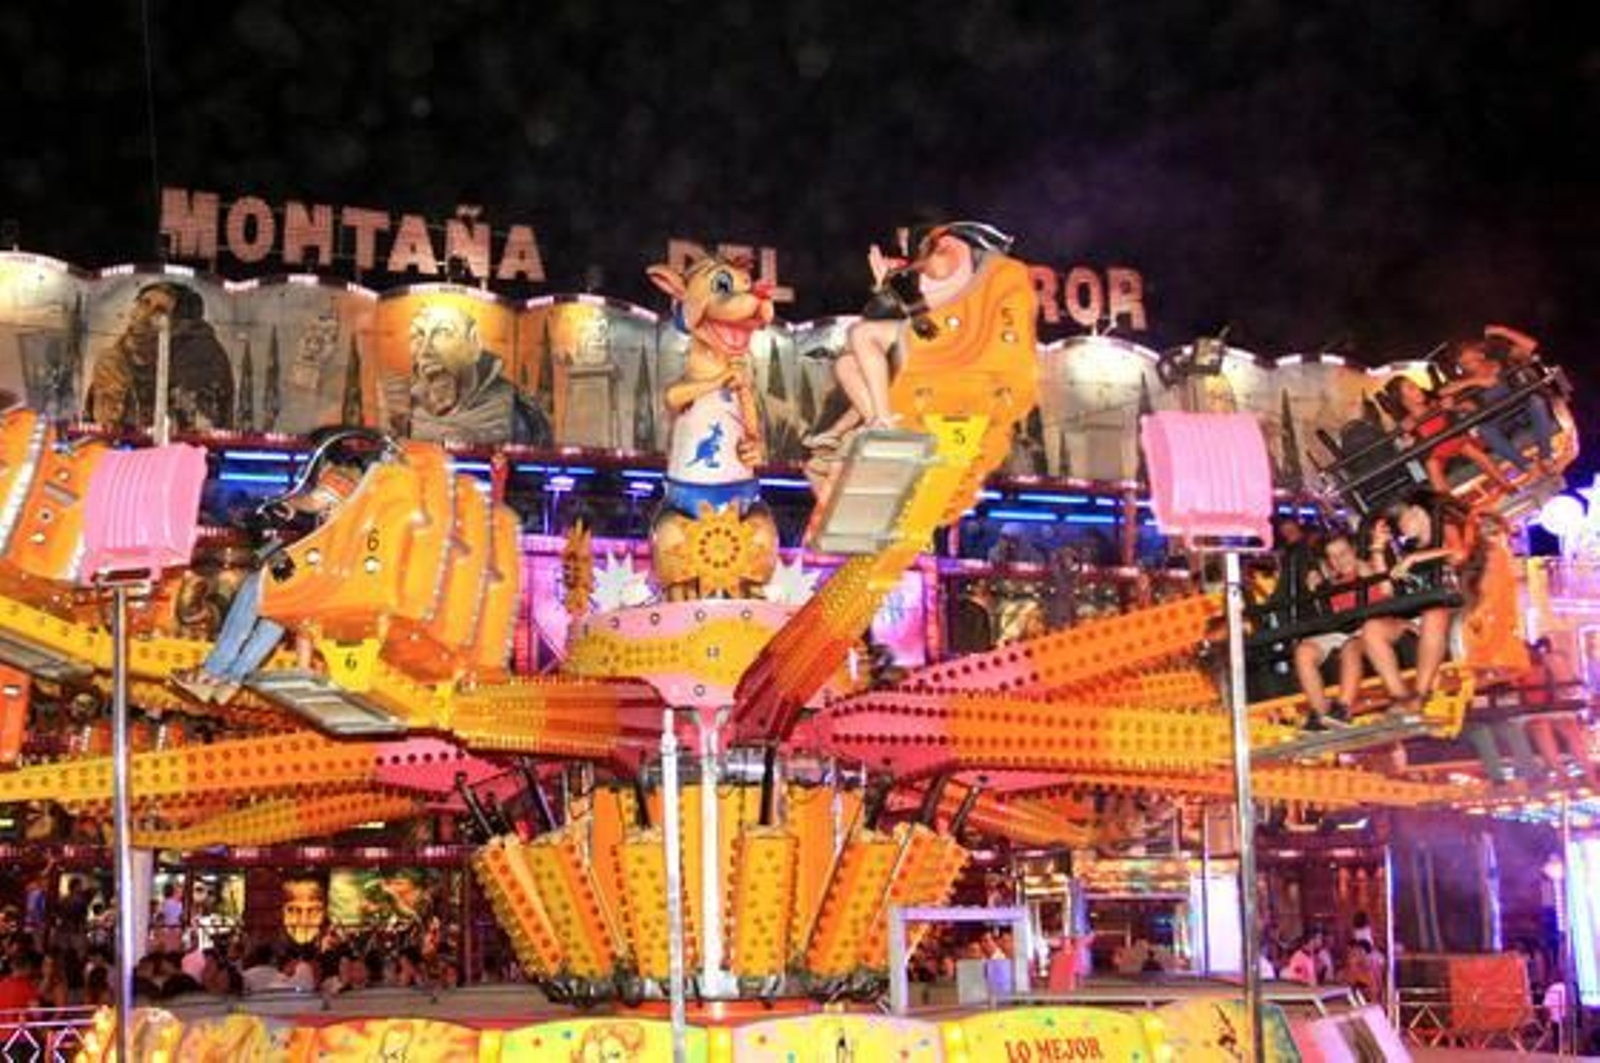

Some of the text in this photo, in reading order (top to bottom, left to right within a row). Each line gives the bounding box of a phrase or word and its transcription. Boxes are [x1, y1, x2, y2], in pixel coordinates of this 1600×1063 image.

[161, 188, 545, 282] MONTAÑA
[1001, 307, 1014, 326] 5
[953, 427, 966, 445] 5
[366, 528, 380, 552] 6
[344, 652, 357, 670] 6
[1034, 1036, 1104, 1063] MEJOR
